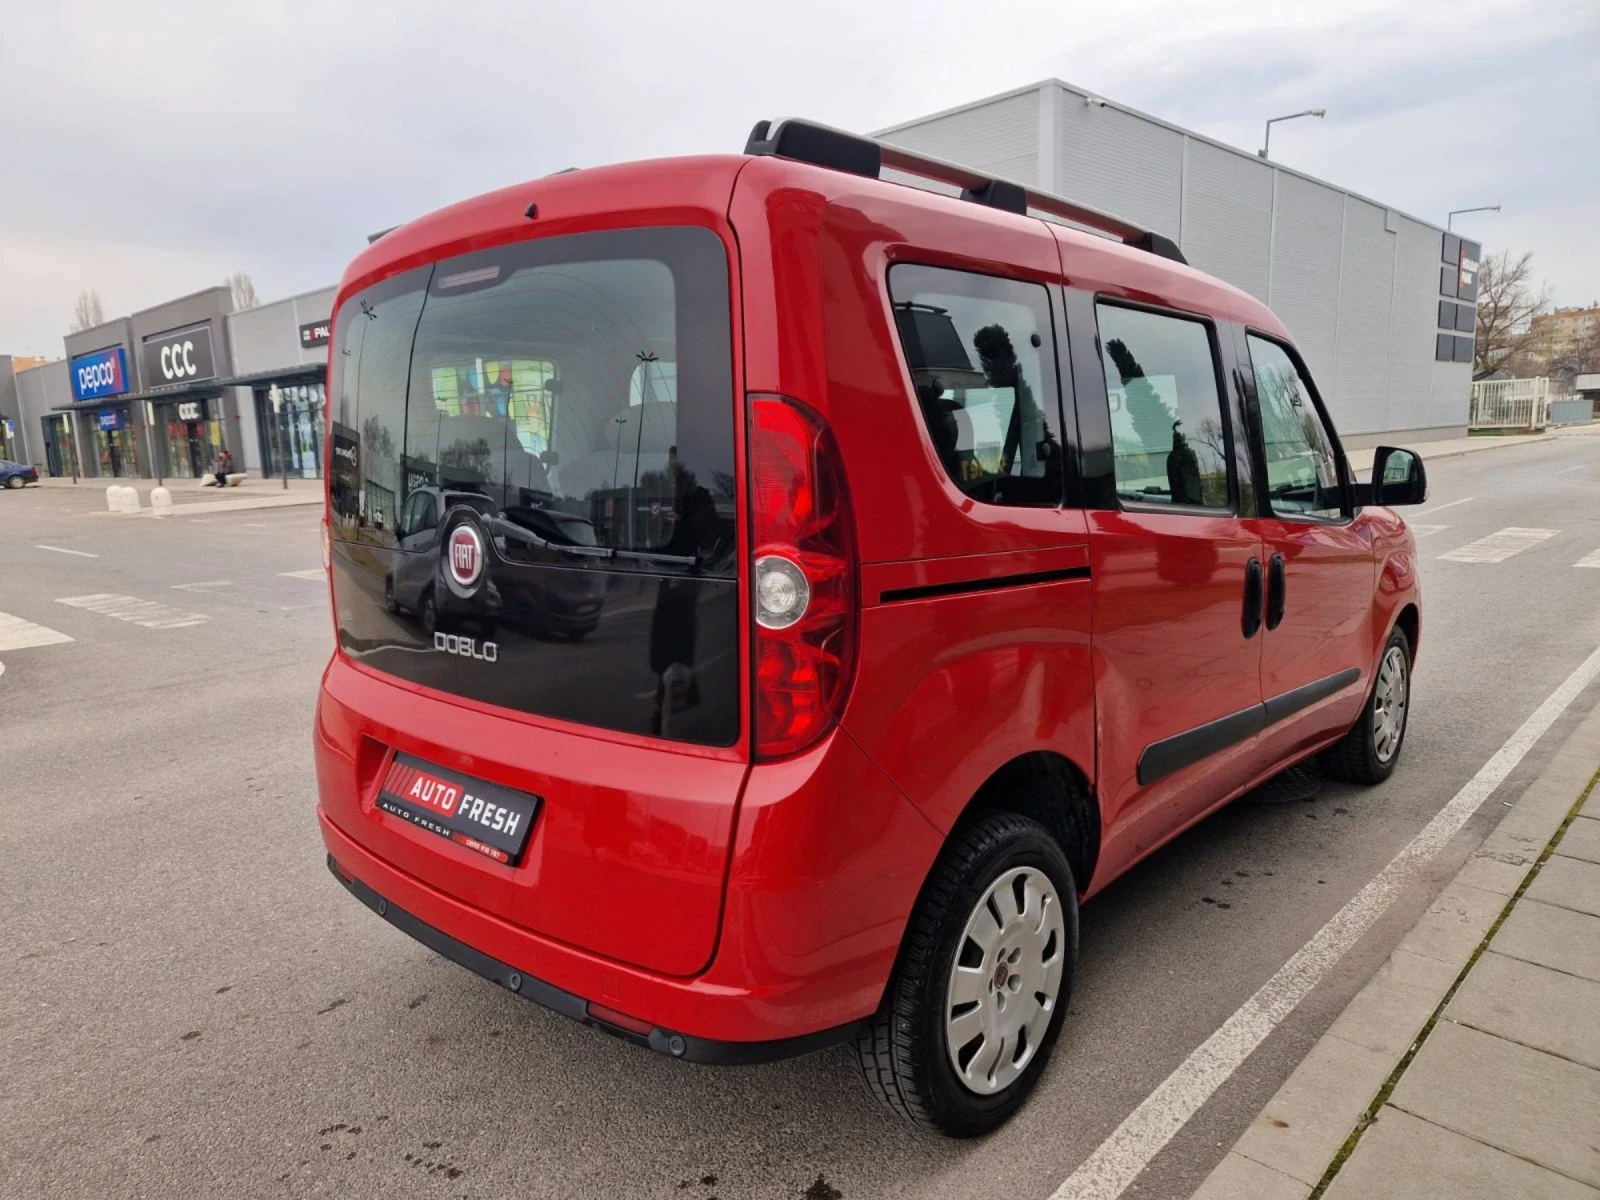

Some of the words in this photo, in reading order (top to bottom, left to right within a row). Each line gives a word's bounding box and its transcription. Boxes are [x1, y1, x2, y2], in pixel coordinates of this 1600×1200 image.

[161, 341, 197, 379] CCC
[78, 360, 115, 395] pepco
[178, 402, 200, 420] CCC
[454, 543, 474, 569] FIAT
[434, 631, 498, 663] DOBLO
[382, 803, 410, 819] AUTO
[414, 816, 450, 836] FRESH
[409, 777, 457, 810] AUTO
[458, 794, 521, 836] FRESH
